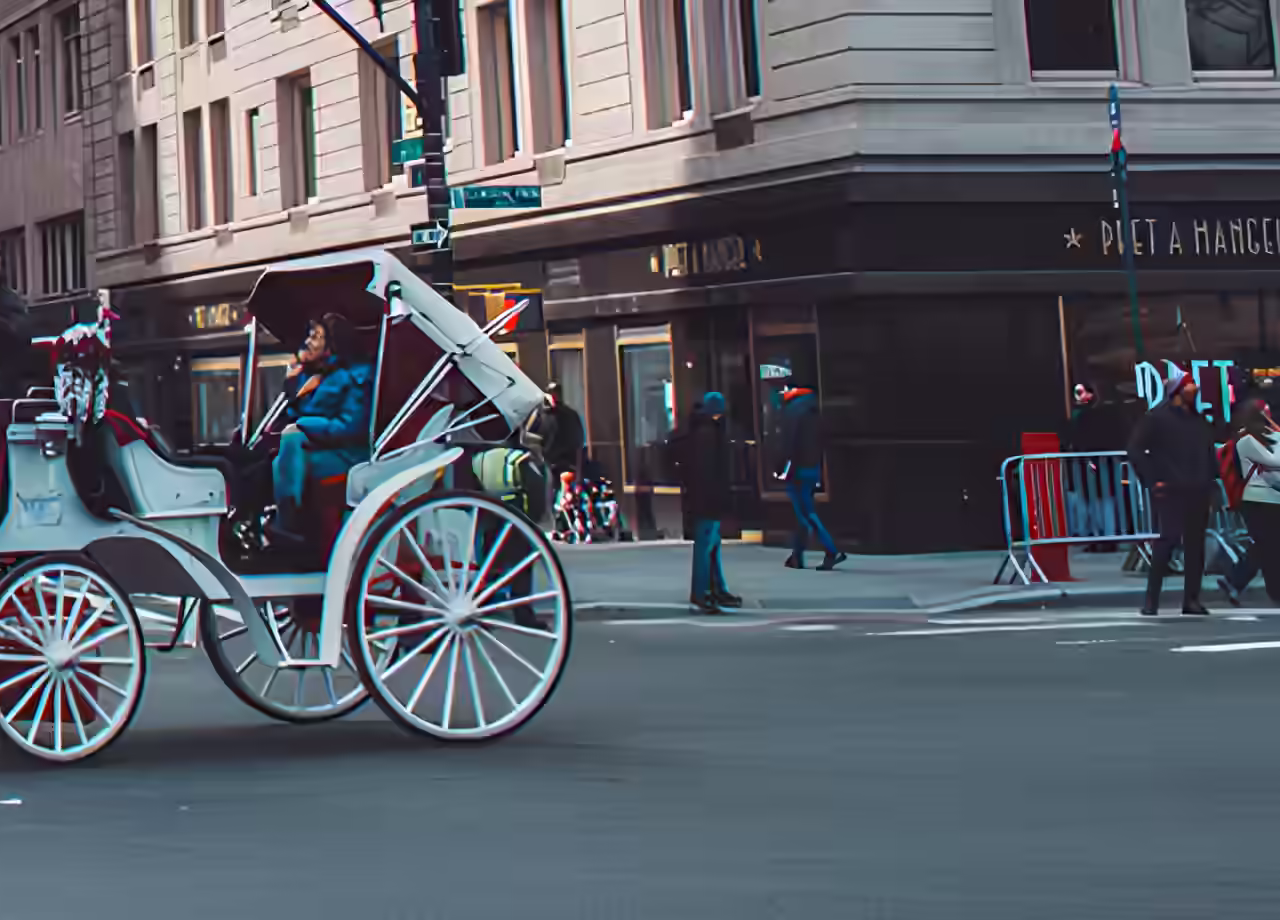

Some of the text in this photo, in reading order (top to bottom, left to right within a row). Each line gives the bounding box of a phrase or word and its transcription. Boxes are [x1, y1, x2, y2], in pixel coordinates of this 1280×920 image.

[1169, 221, 1183, 255] A
[1193, 218, 1280, 255] MANGE
[1135, 359, 1234, 423] PET
